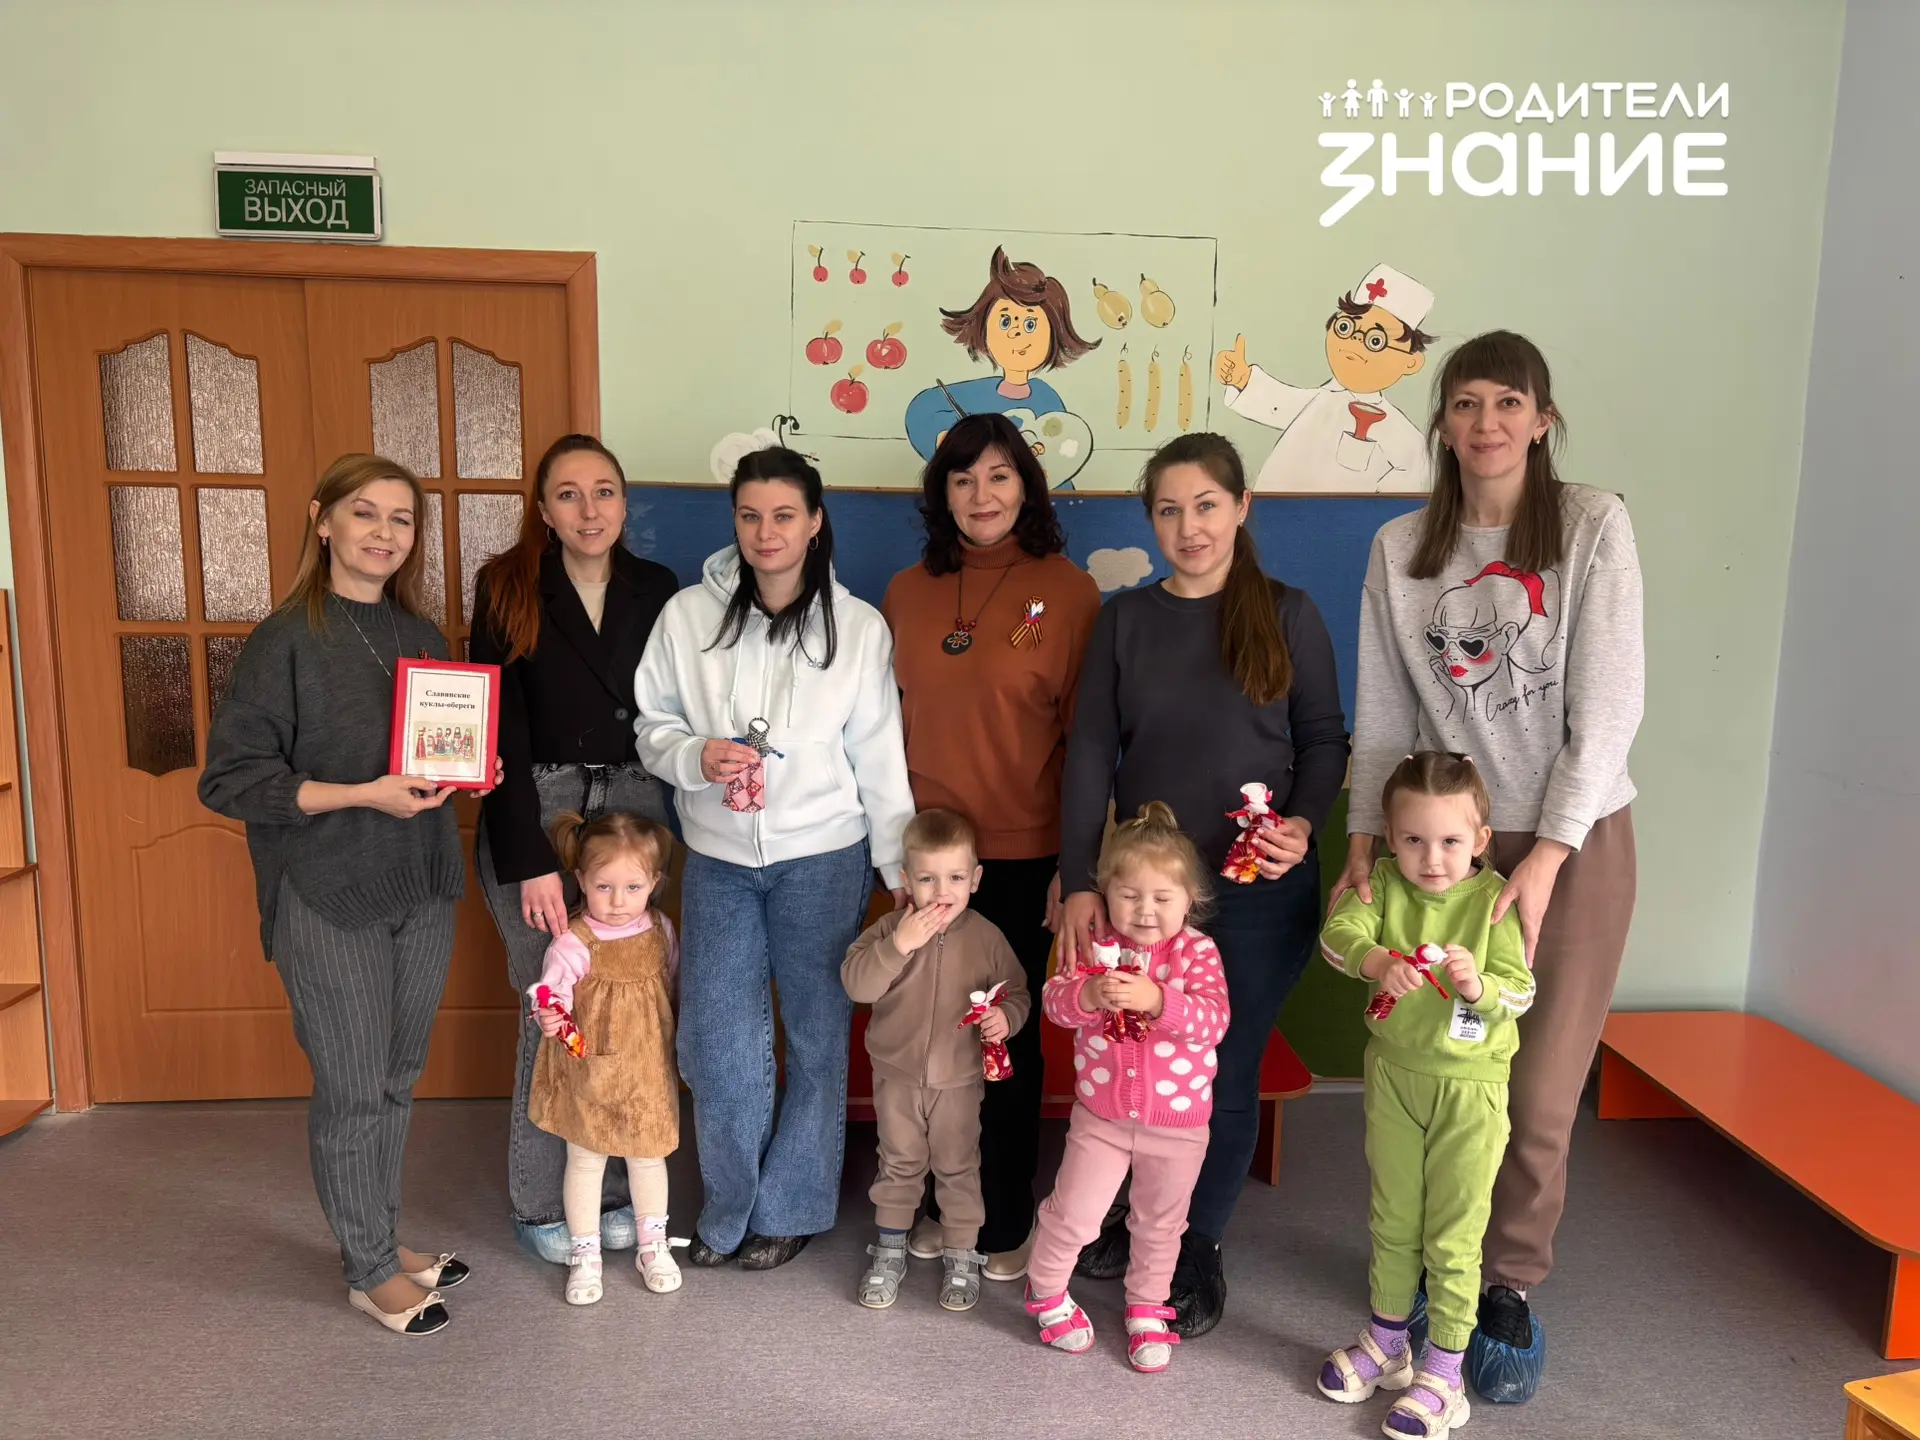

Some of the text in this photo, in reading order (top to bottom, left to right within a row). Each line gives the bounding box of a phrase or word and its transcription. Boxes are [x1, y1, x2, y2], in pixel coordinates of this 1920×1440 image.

[244, 178, 347, 197] ЗАПАСНЫЙ
[244, 197, 349, 230] ВЫХОД
[425, 689, 471, 700] Славянские
[1522, 683, 1536, 707] for
[419, 701, 476, 711] куклы-обереги
